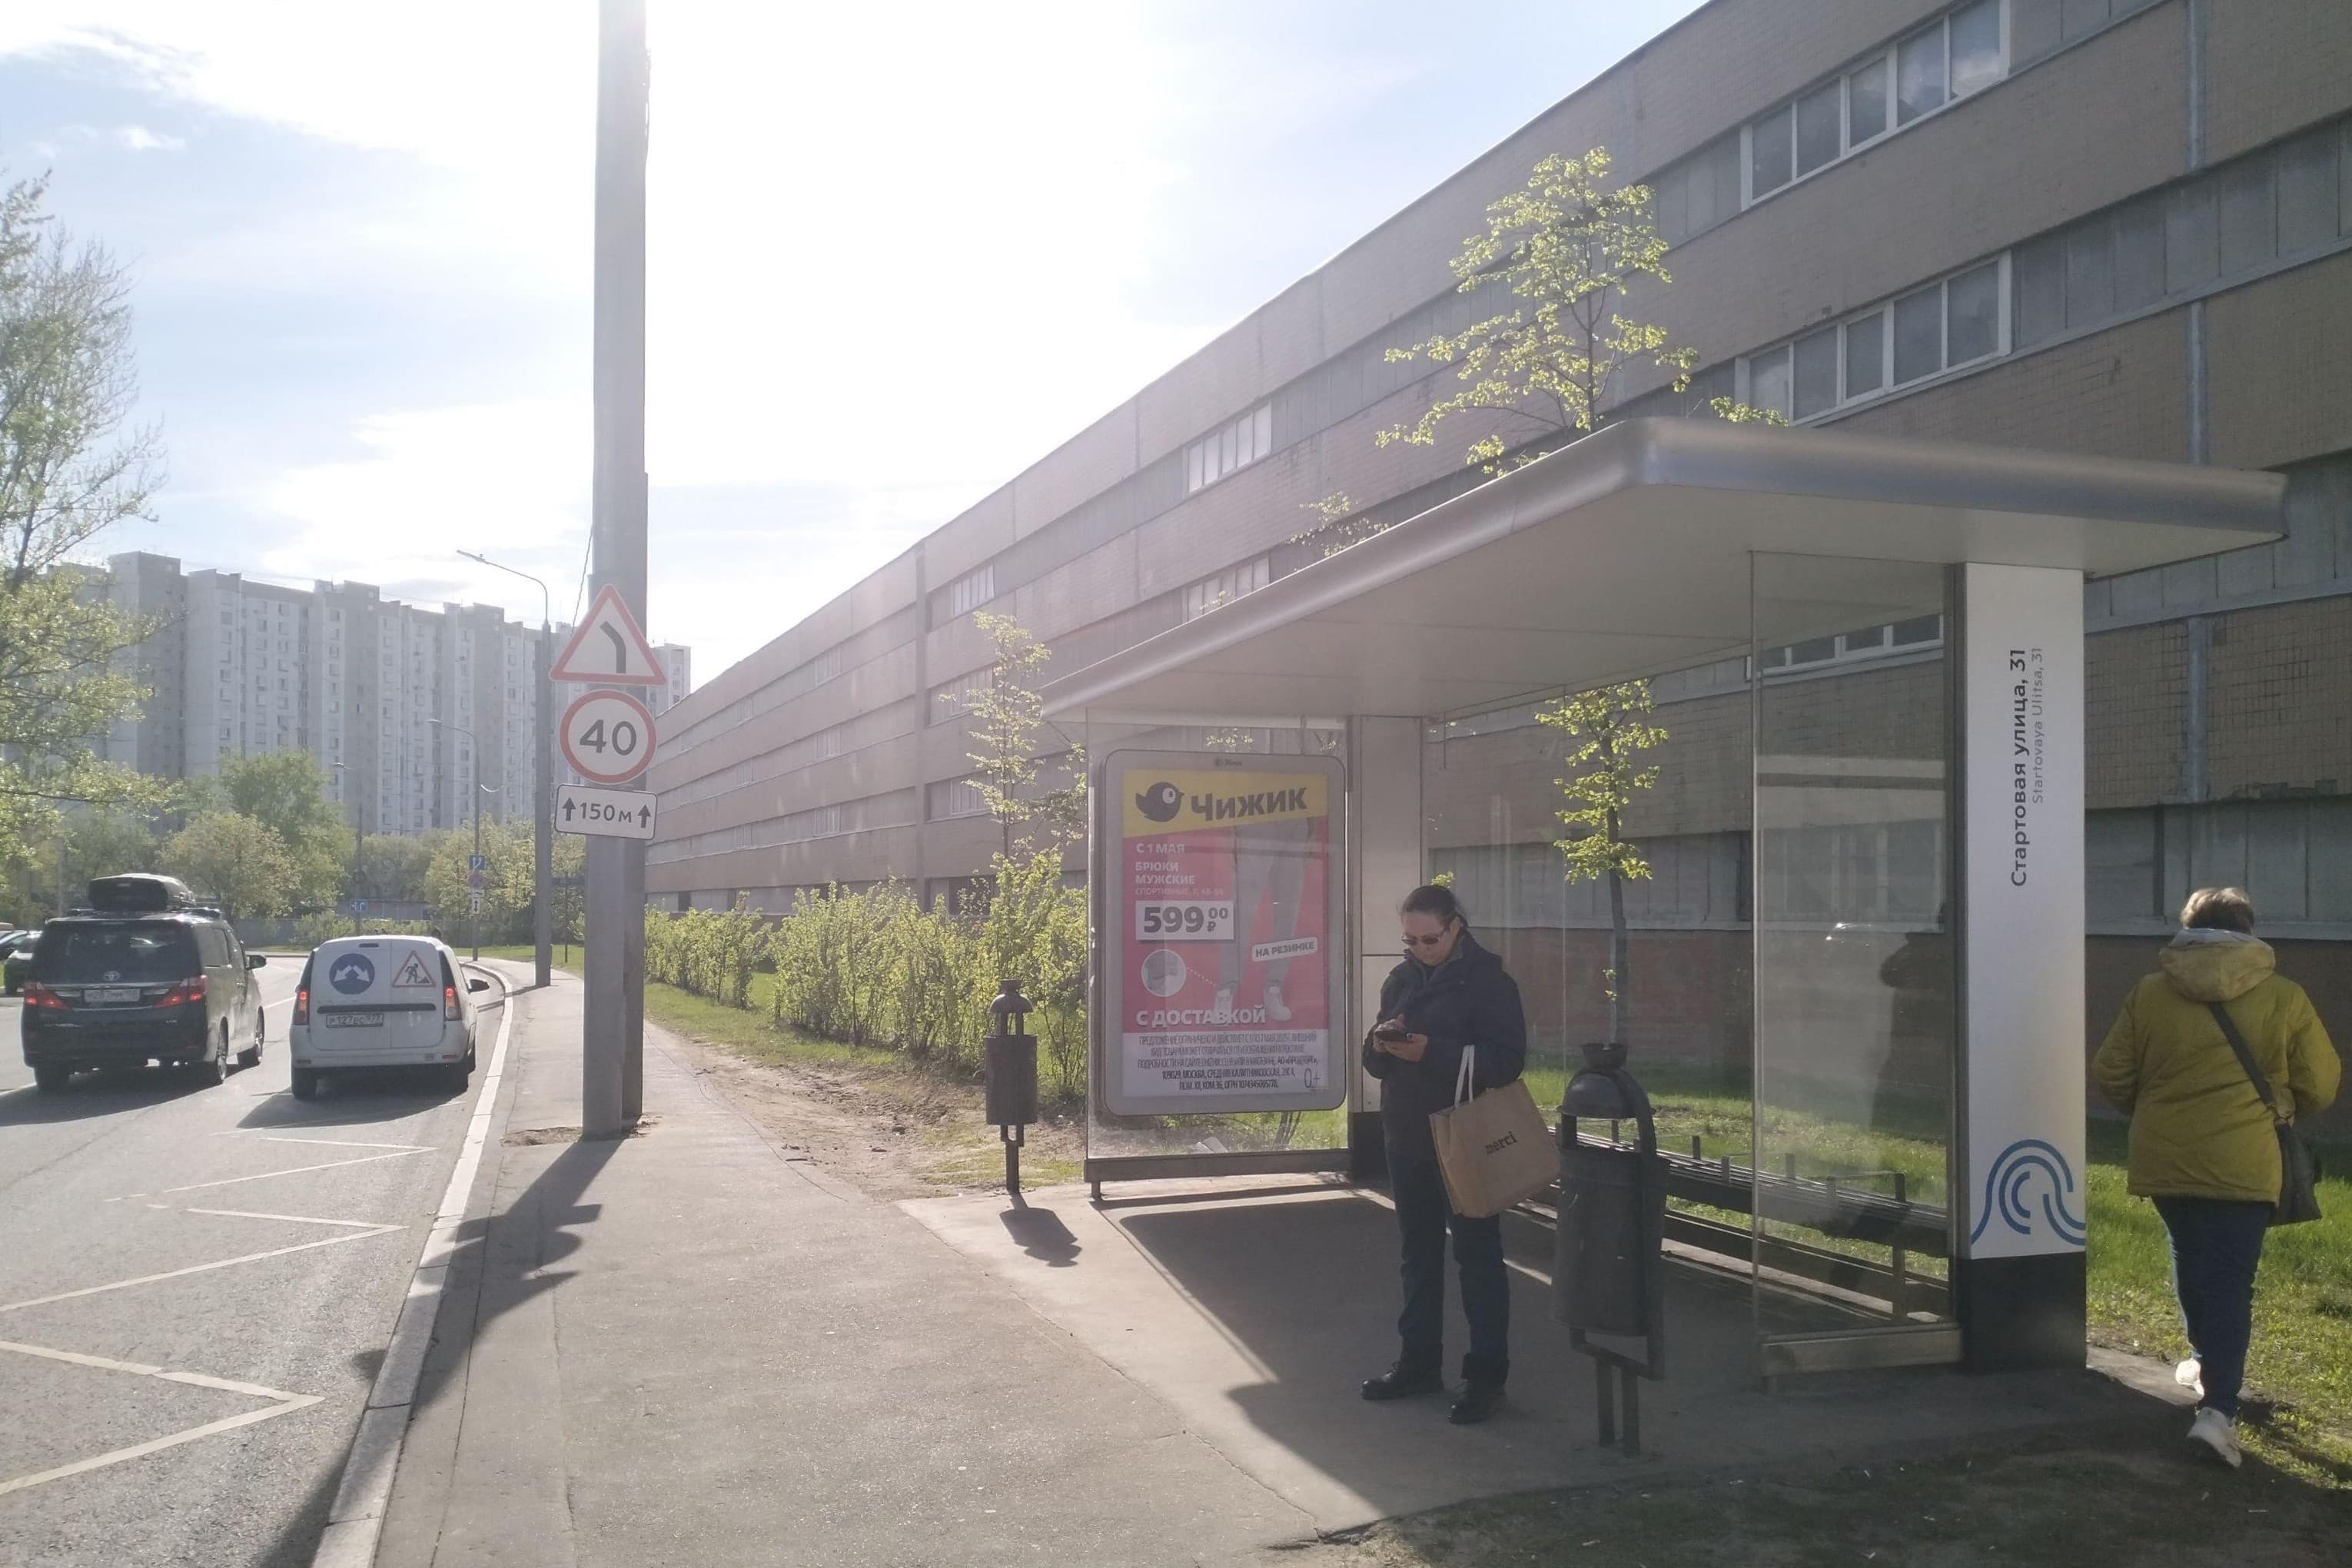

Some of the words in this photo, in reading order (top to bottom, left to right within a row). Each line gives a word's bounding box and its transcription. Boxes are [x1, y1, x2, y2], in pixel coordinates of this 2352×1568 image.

[2010, 649, 2026, 672] 31
[2031, 647, 2042, 662] 31
[2031, 667, 2044, 716] Ulitsa,
[2012, 679, 2030, 756] улица,
[579, 719, 637, 756] 40
[2032, 721, 2045, 804] Startovaya
[2011, 762, 2030, 886] Стартовая
[1137, 843, 1144, 853] С
[1148, 843, 1153, 853] 1
[1156, 843, 1185, 853] МАЯ
[1135, 862, 1178, 872] БРЮКИ
[1135, 875, 1196, 885] МУЖСКИЕ
[1144, 905, 1204, 933] 599
[1208, 907, 1228, 919] 00
[1255, 948, 1269, 958] НА
[1271, 942, 1315, 955] РЕЗИНКЕ
[1136, 1010, 1148, 1025] С
[1151, 1005, 1266, 1028] ДОСТАВКОЙ
[1304, 1068, 1321, 1088] 0+
[1484, 1131, 1517, 1155] merci
